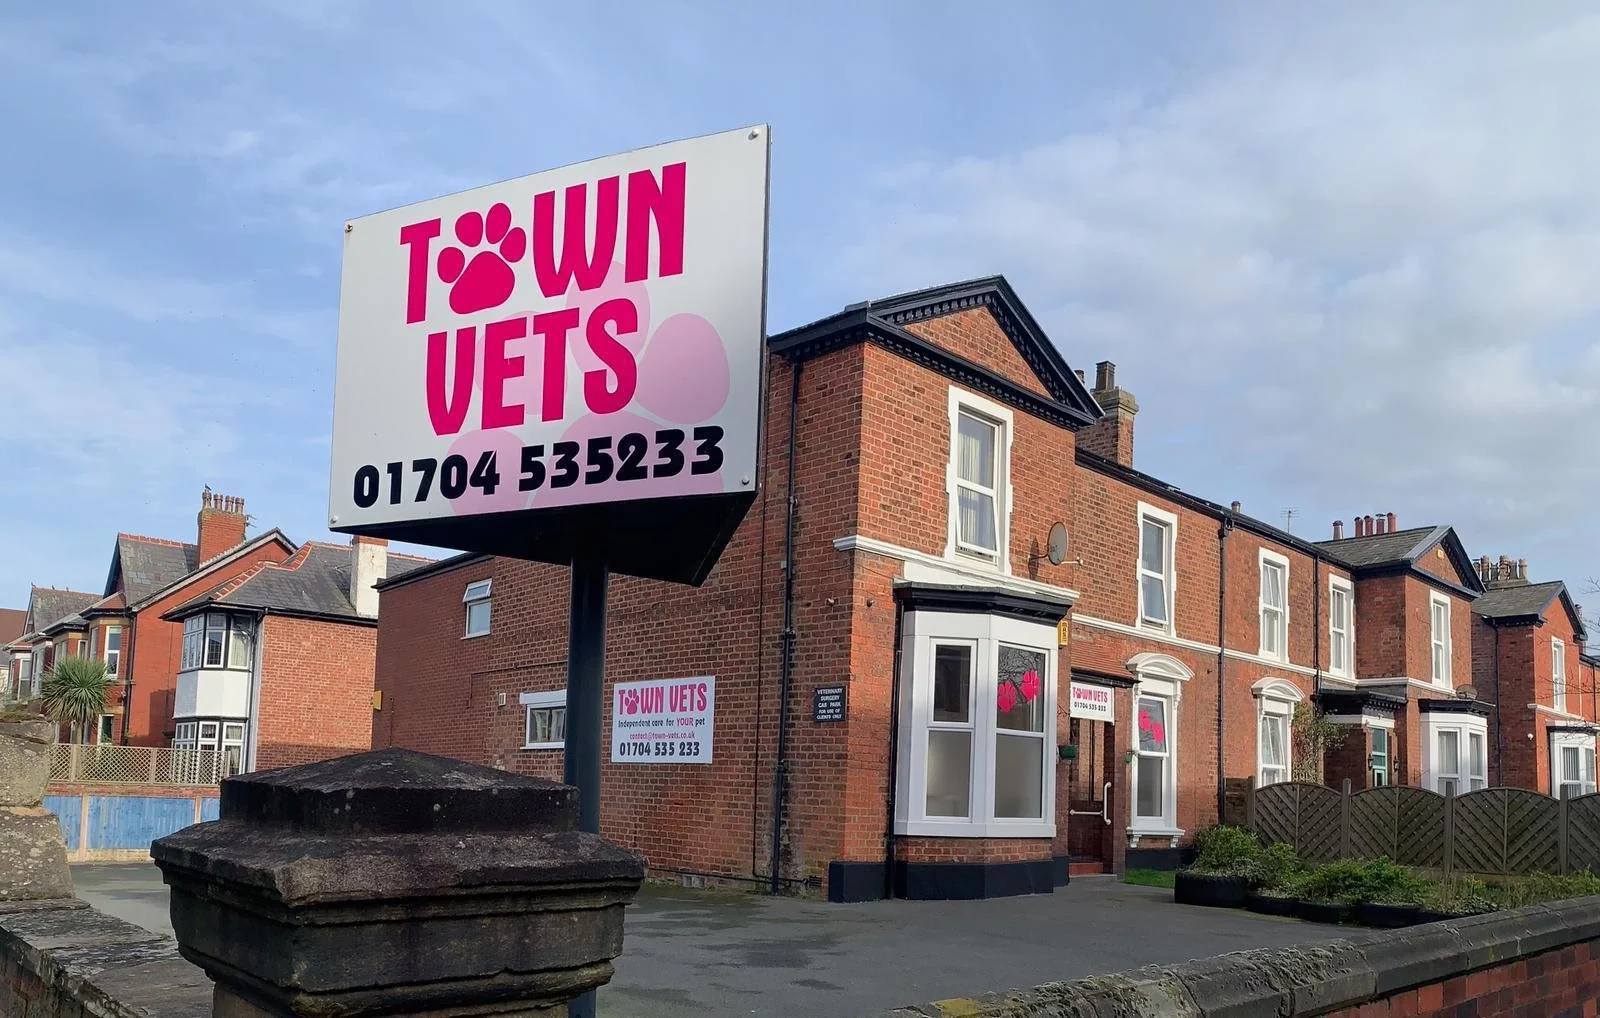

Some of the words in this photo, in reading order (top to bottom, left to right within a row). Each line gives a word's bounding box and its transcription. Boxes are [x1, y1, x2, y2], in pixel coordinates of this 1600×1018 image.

[426, 298, 638, 436] VETS
[353, 450, 500, 508] 01704
[518, 425, 724, 492] 535233
[669, 683, 707, 712] VETS
[1093, 690, 1108, 703] VETS
[618, 719, 651, 729] Independent
[651, 719, 663, 727] care
[666, 718, 674, 727] for
[676, 717, 694, 727] YOUR
[695, 718, 705, 728] pet
[620, 742, 651, 756] 01704
[654, 741, 675, 756] 535
[679, 741, 700, 756] 233
